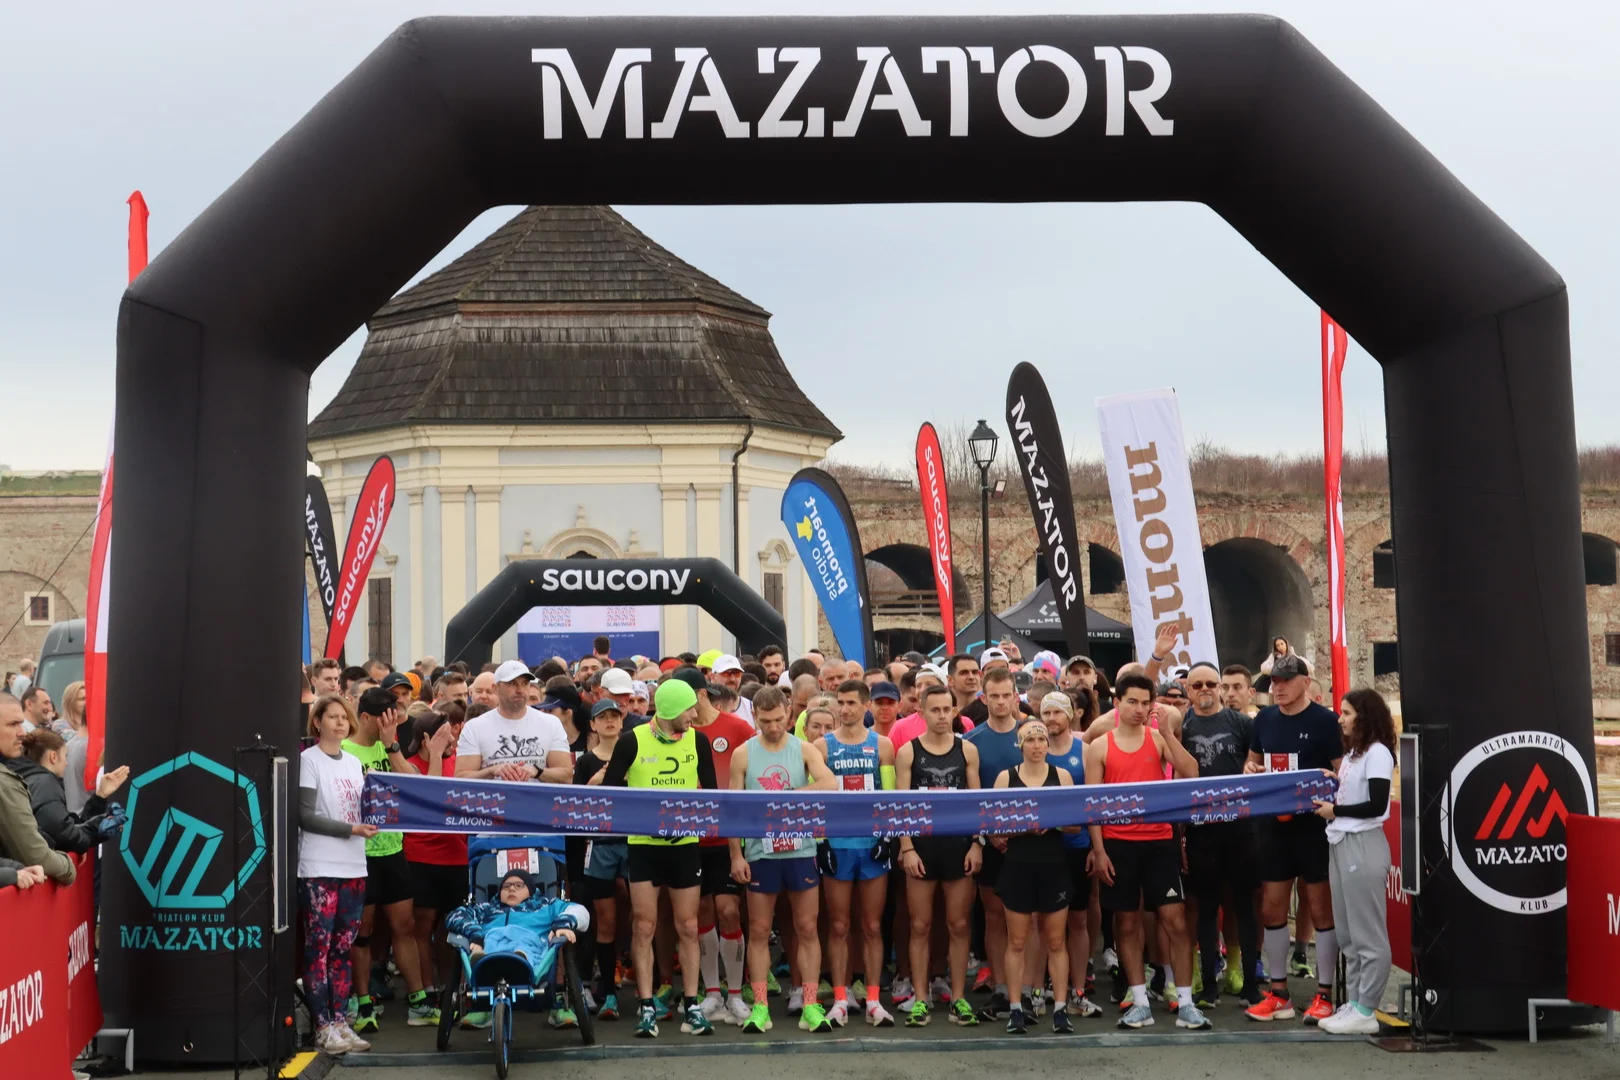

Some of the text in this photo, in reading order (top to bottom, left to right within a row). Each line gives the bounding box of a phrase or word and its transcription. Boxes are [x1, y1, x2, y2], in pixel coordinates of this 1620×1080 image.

[531, 45, 1174, 139] MAZATOR
[925, 445, 949, 562] saucony
[1011, 395, 1077, 609] MAZATOR
[305, 494, 336, 616] MAZATO
[336, 504, 377, 626] saucony
[541, 568, 690, 595] saucony
[1087, 631, 1120, 639] XLMOTO
[1481, 734, 1566, 755] ULTRAMARATON
[834, 758, 874, 769] CROATIA
[651, 777, 686, 786] Dechra
[201, 913, 226, 923] KLUB
[1520, 899, 1549, 912] KLUB
[119, 925, 263, 951] MAZATOR
